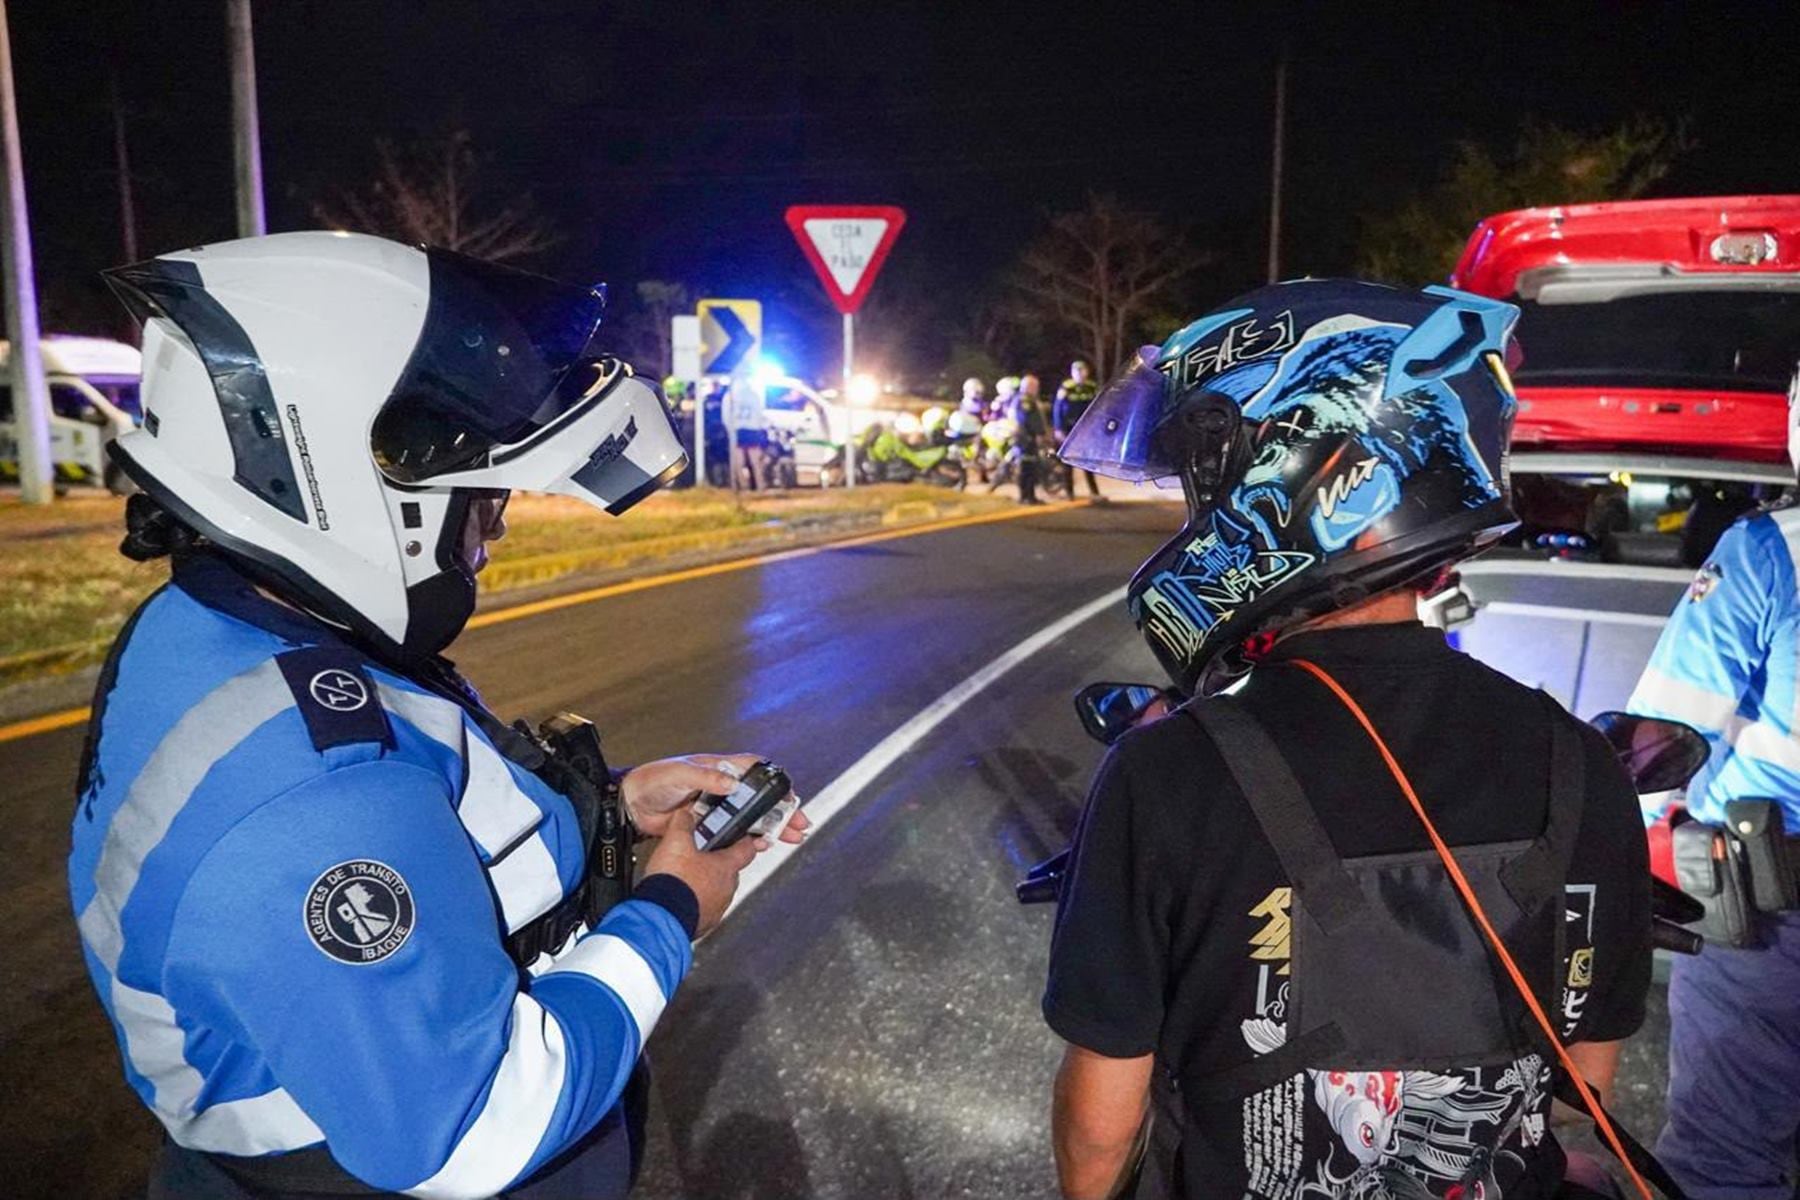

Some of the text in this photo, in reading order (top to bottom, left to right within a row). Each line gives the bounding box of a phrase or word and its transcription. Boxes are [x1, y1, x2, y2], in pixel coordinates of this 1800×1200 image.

[831, 224, 862, 238] CEDA
[310, 863, 406, 942] AGENTES DE TRANSITO
[362, 925, 408, 960] IBAGUE
